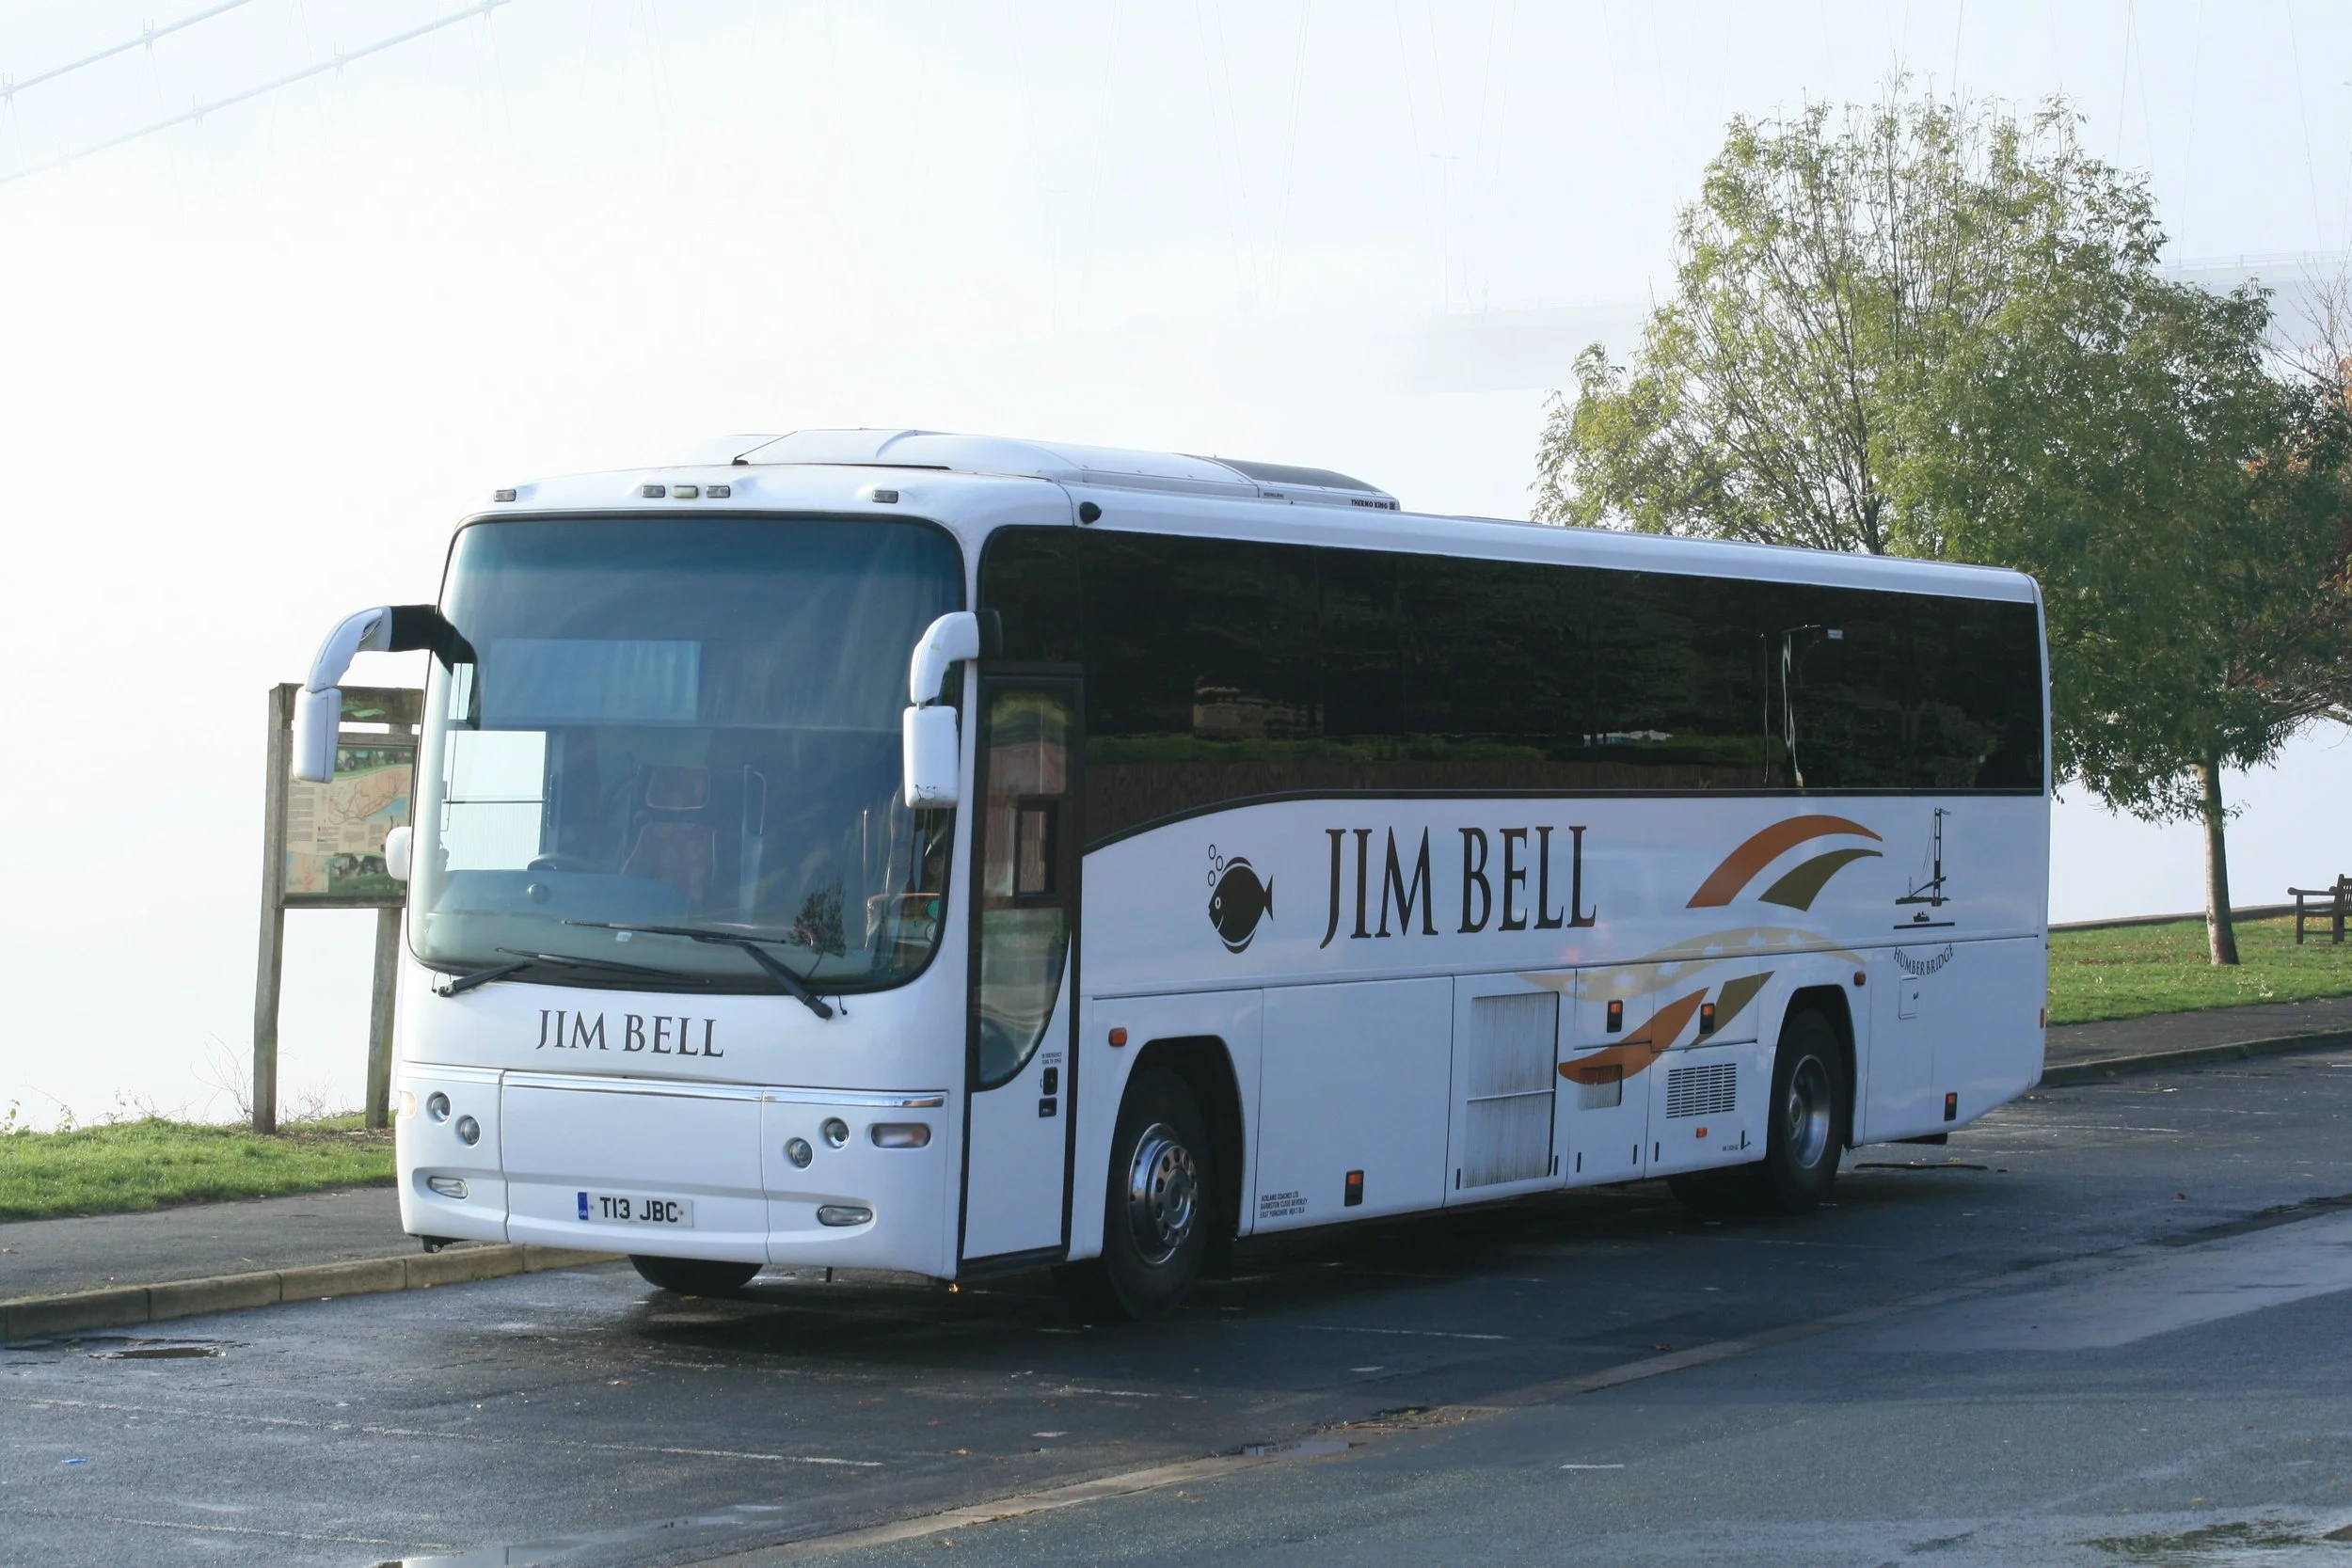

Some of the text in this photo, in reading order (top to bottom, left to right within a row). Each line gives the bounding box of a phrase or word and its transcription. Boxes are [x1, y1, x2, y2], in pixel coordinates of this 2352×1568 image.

[1351, 499, 1389, 510] THERMO KING
[1320, 825, 1597, 950] JIM BELL
[1894, 942, 1953, 975] HUMBER BRIDGE
[535, 1009, 724, 1057] JIM BELL
[599, 1196, 678, 1223] T13 JBC
[1292, 1197, 1308, 1206] BEVERLEY
